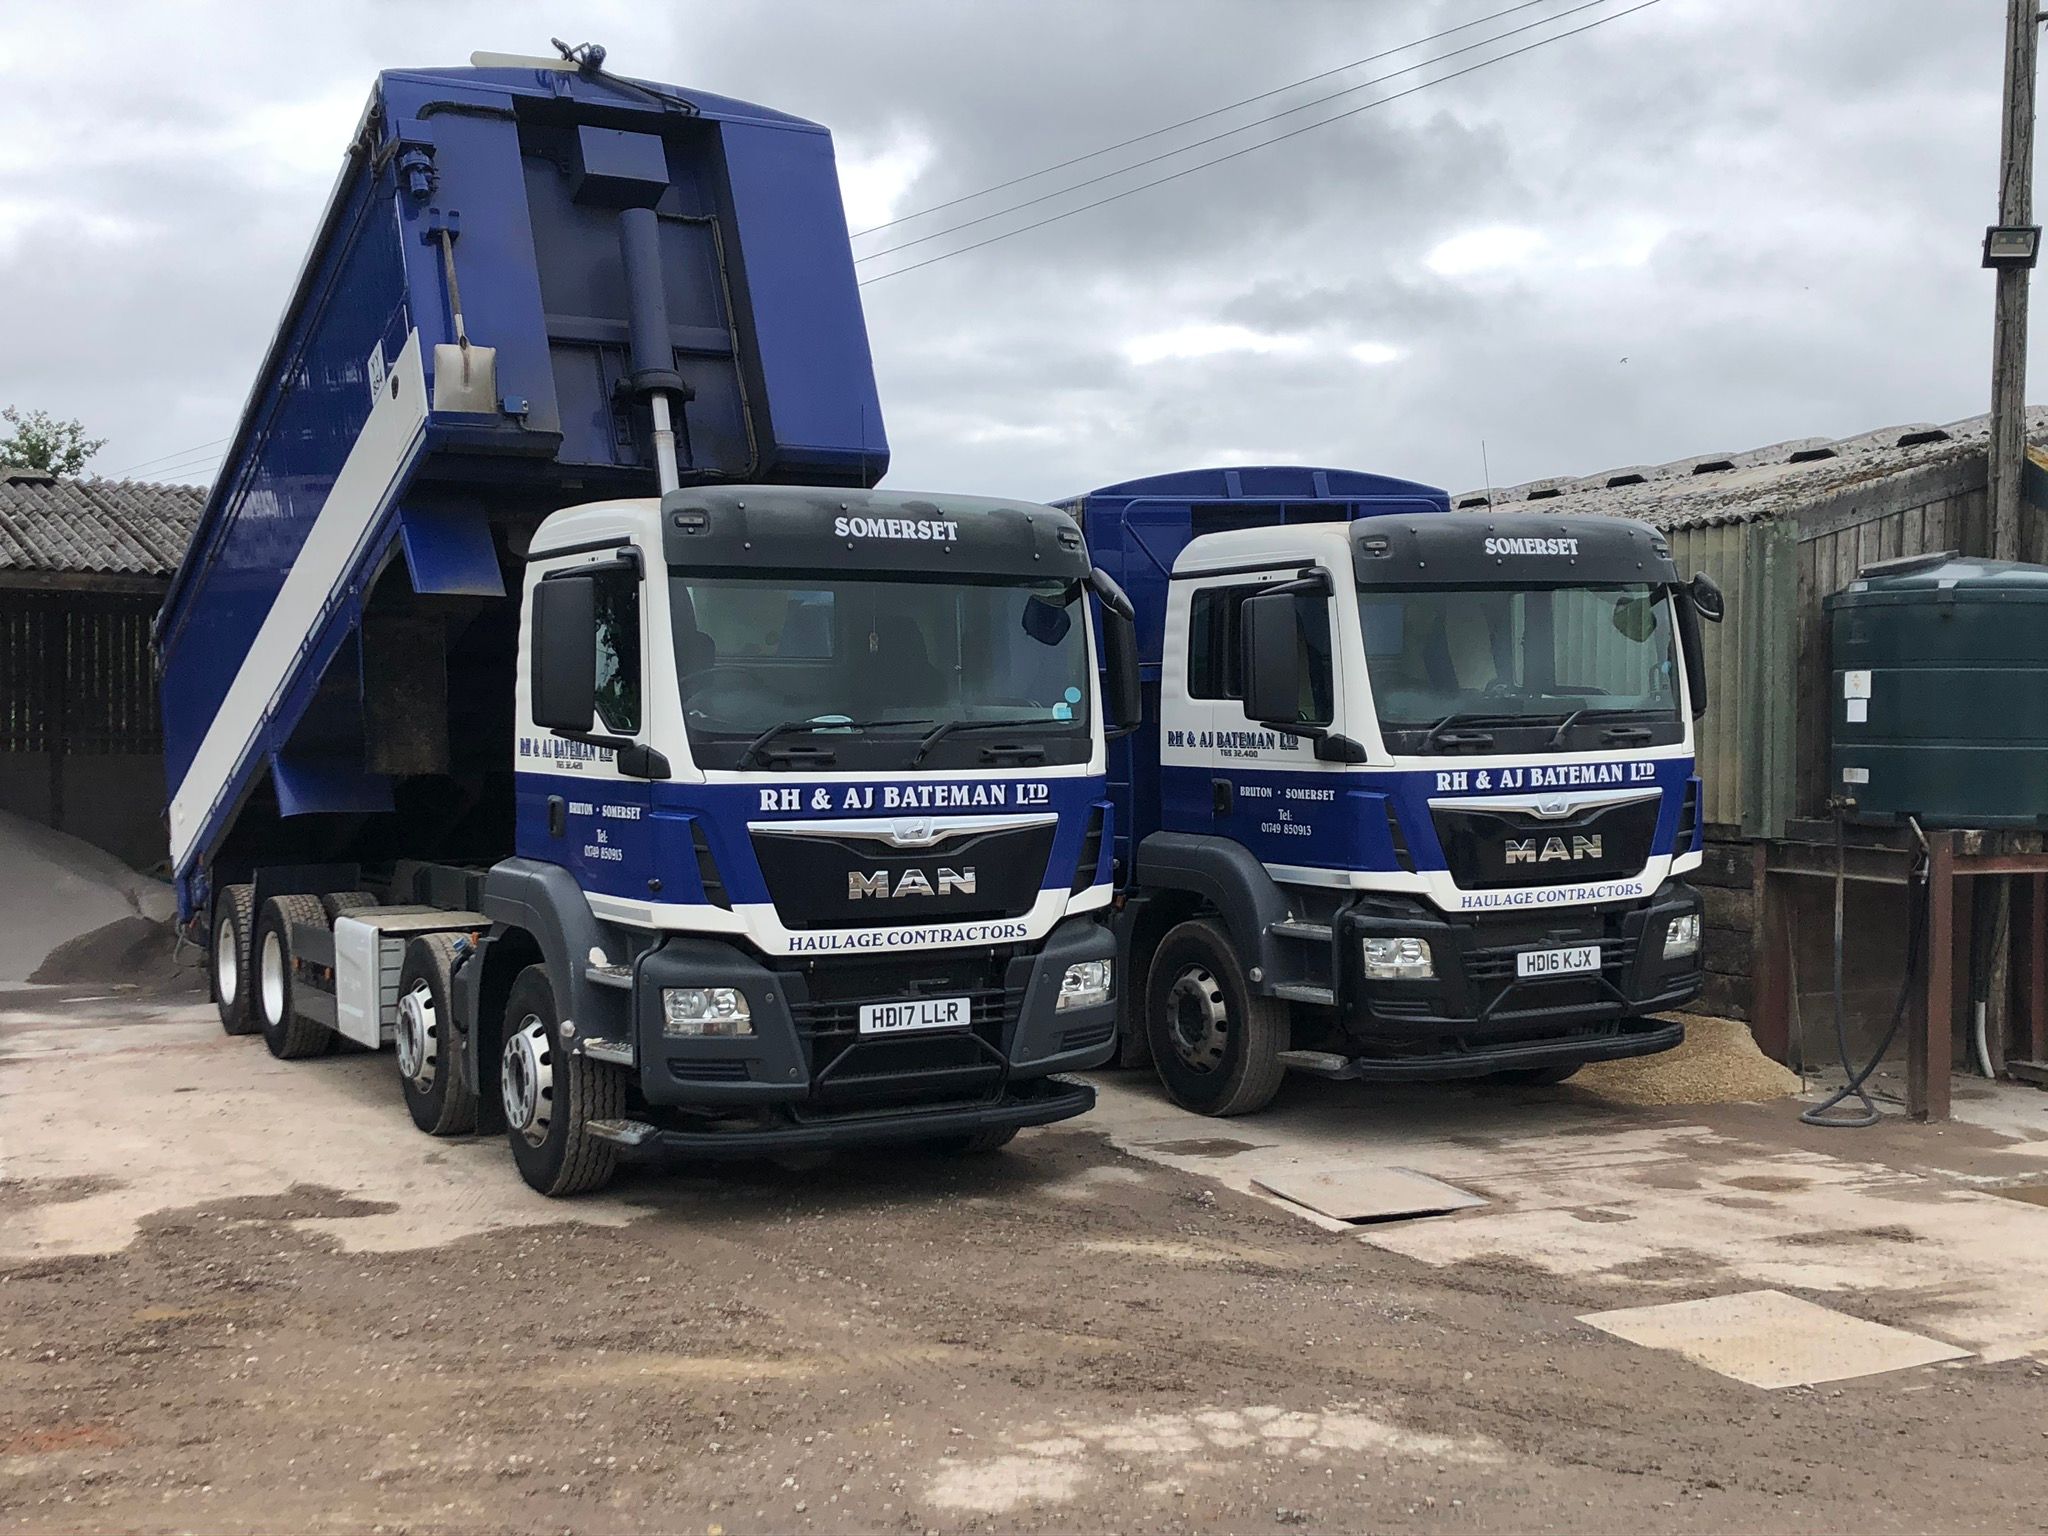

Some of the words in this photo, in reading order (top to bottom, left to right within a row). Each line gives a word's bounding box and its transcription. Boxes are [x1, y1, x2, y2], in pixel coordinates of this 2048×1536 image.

[834, 516, 958, 541] SOMERSET
[1485, 537, 1579, 555] SOMERSET
[1168, 731, 1184, 748] RH
[1187, 731, 1196, 748] &
[1200, 731, 1214, 748] AJ
[1216, 732, 1276, 750] BATEMAN
[1437, 772, 1468, 791] RH
[1475, 771, 1492, 789] &
[1500, 769, 1524, 788] AJ
[1530, 764, 1624, 786] BATEMAN
[760, 789, 800, 811] RH
[811, 788, 832, 810] &
[843, 787, 874, 809] AJ
[883, 784, 1006, 808] BATEMAN
[1240, 786, 1272, 798] BRUTON
[1285, 788, 1335, 801] SOMERSET
[602, 805, 641, 820] SOMERSET
[1278, 809, 1293, 821] Tel:
[1261, 822, 1281, 834] 01749
[1283, 824, 1312, 836] 850913
[1505, 834, 1603, 864] MAN
[848, 867, 976, 900] MAN
[1461, 891, 1533, 908] HAULAGE
[1536, 883, 1643, 902] CONTRACTORS
[789, 932, 884, 951] HAULAGE
[887, 923, 1028, 945] CONTRACTORS
[1526, 954, 1559, 972] HD16
[1563, 950, 1592, 968] KJX
[872, 1005, 915, 1028] HD17
[921, 1001, 958, 1024] LLR
